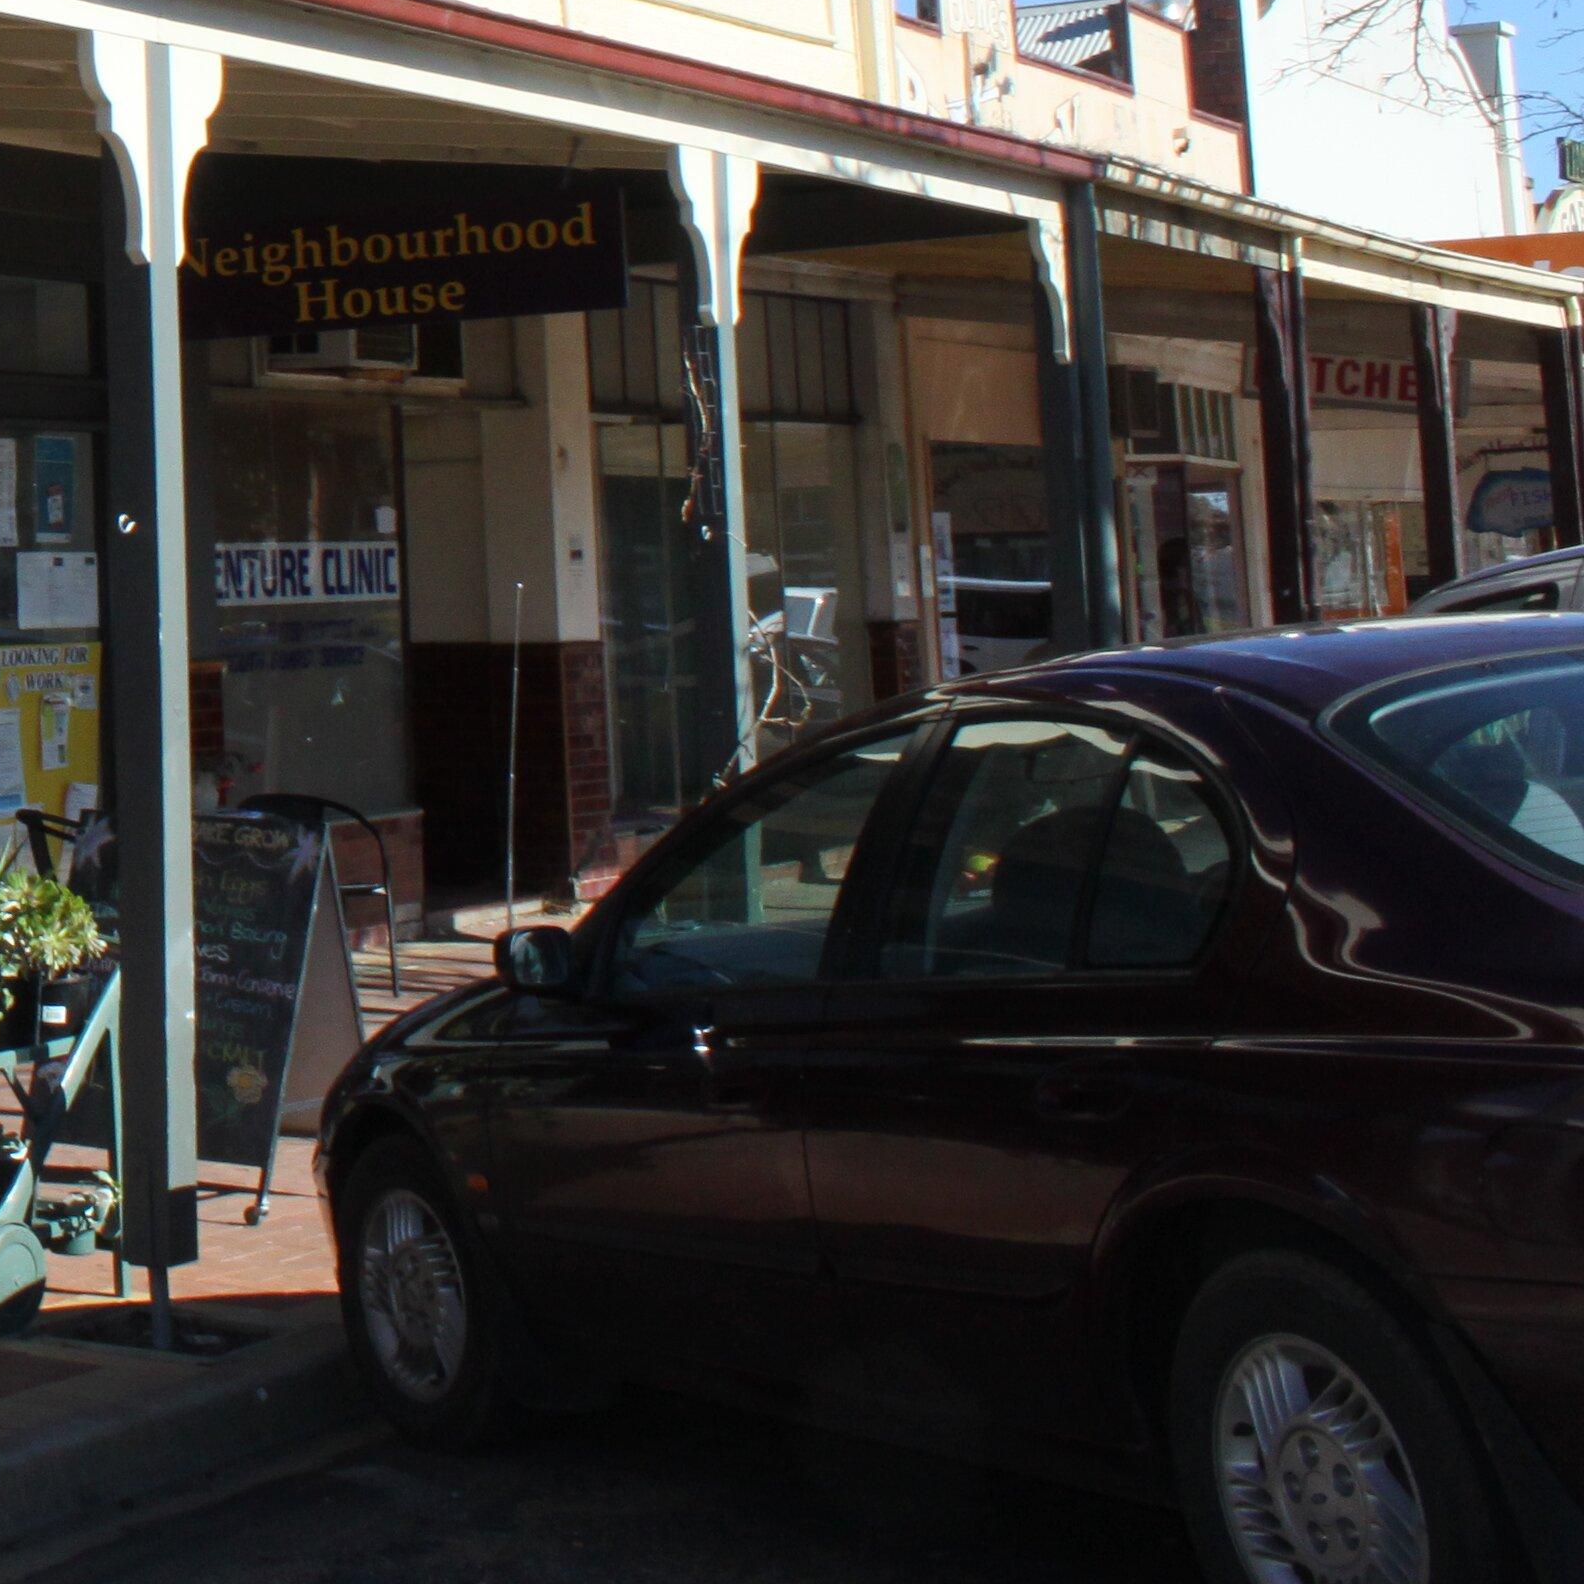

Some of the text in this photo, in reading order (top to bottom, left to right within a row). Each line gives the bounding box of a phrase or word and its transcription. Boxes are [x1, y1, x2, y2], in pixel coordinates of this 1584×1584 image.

[180, 202, 597, 286] Neighbourhood
[296, 276, 467, 322] House
[322, 548, 397, 594] CLINIC
[1, 646, 89, 666] LOOKING FOR
[25, 671, 66, 691] WORK
